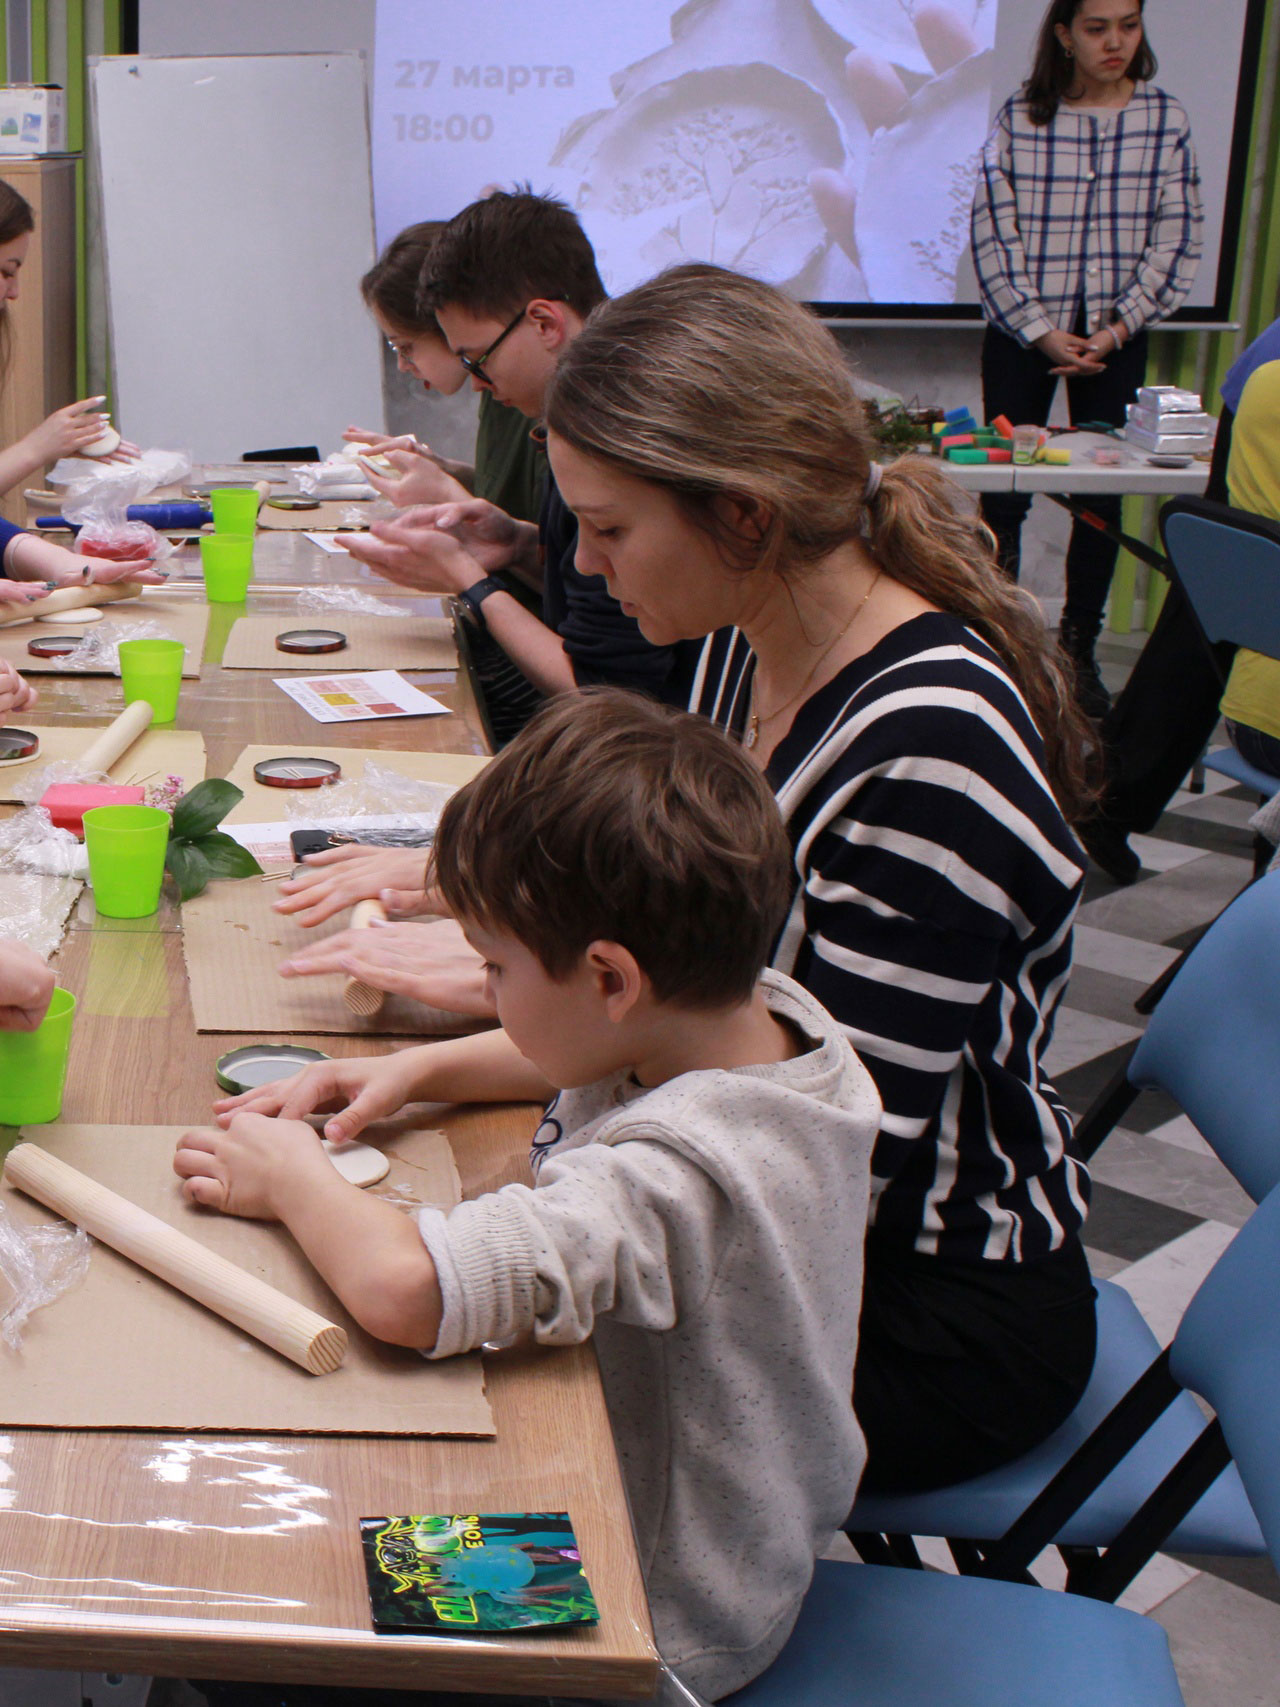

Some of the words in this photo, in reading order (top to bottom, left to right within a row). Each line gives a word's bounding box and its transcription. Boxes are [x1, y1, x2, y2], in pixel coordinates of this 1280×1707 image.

[394, 60, 440, 88] 27
[453, 65, 574, 95] марта
[393, 113, 494, 142] 18:00
